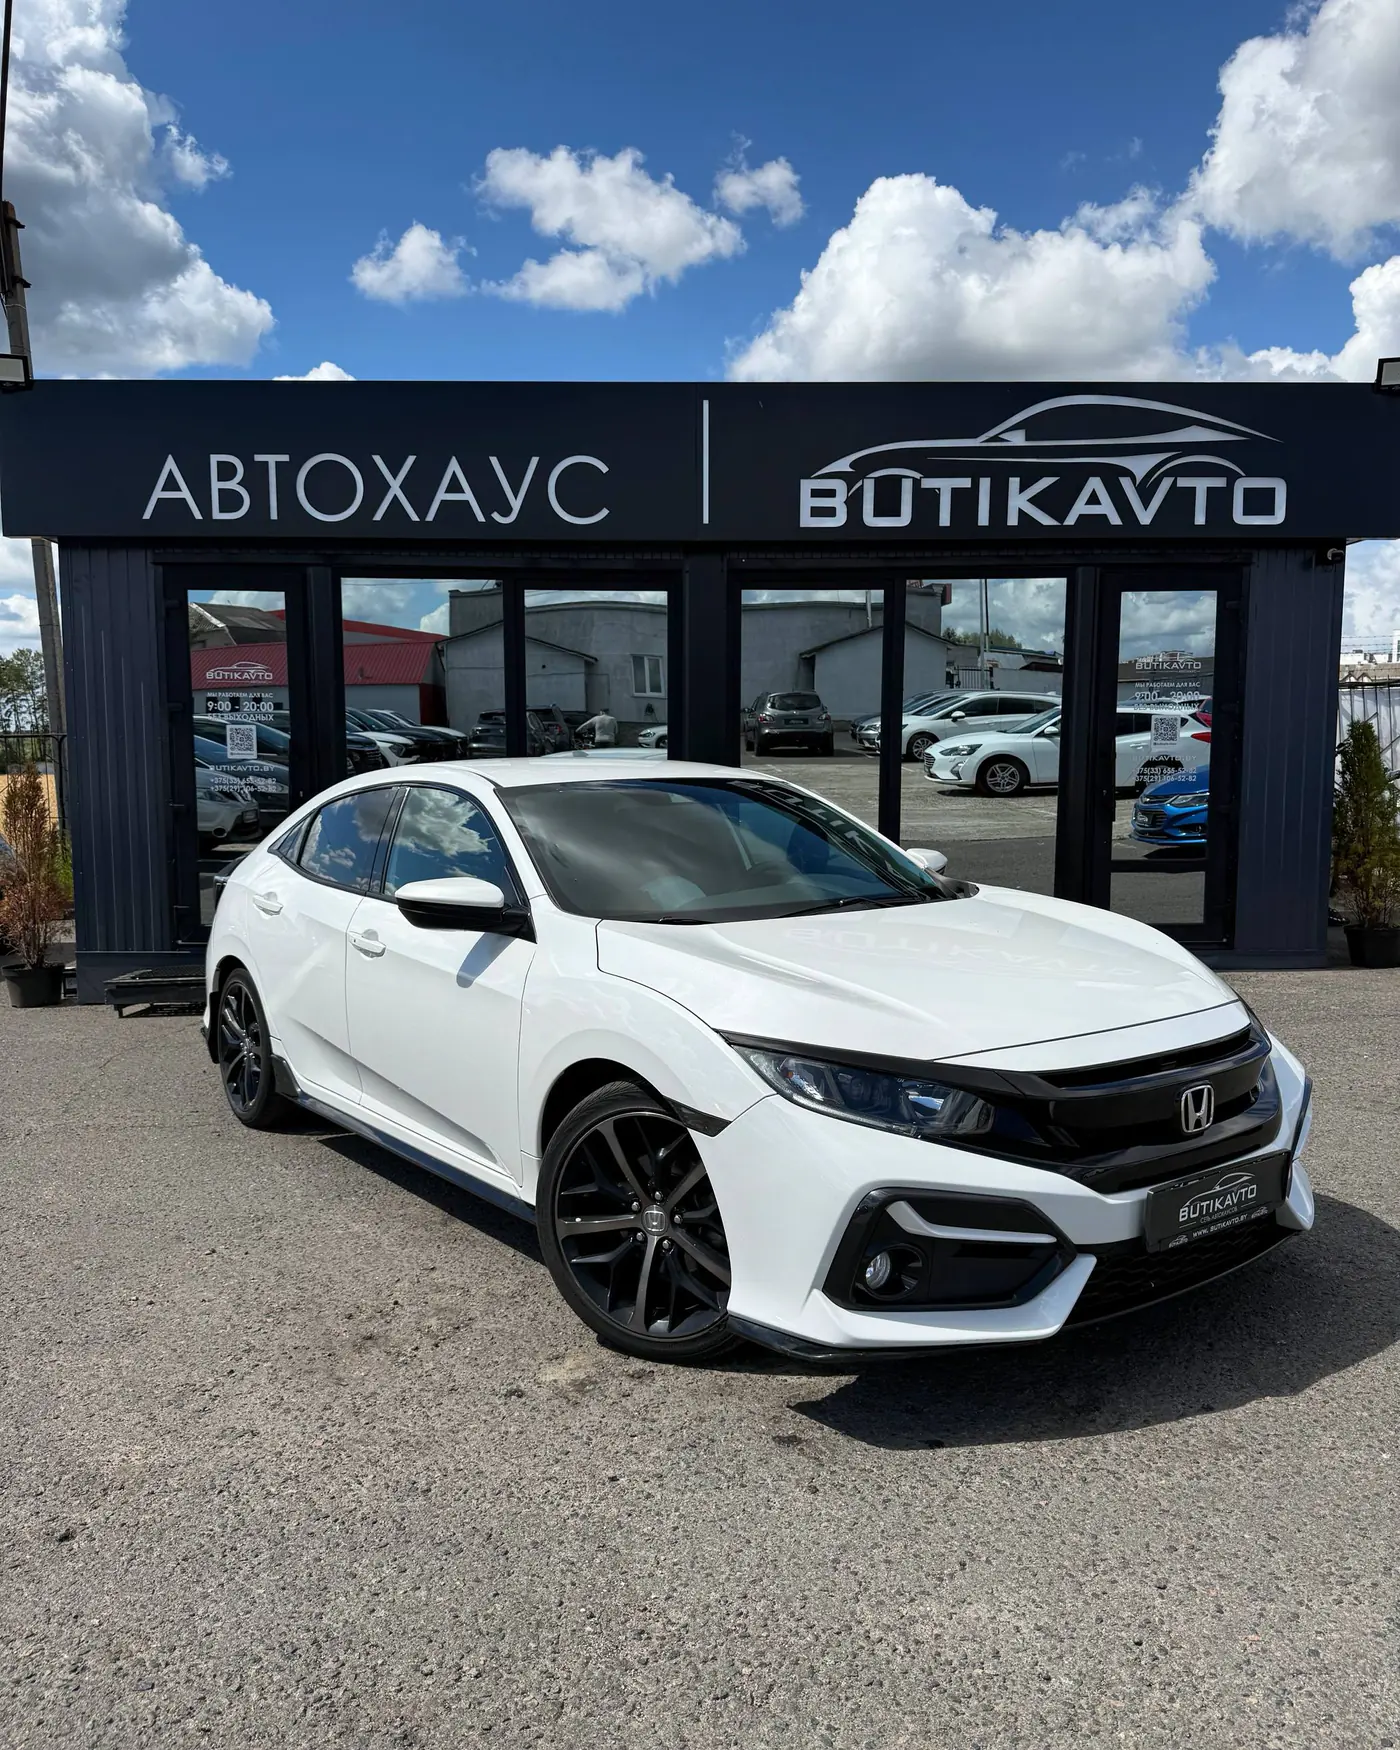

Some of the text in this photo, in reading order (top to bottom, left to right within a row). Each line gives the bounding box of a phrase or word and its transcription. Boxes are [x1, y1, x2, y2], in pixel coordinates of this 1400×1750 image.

[142, 453, 610, 525] АВТОХАУС
[799, 475, 1288, 529] BUTIKAVTO
[206, 671, 273, 680] BUTIKAVTO
[1135, 661, 1202, 670] BUTIKAVTO
[207, 701, 232, 711] 9:00
[243, 701, 274, 712] 20:00
[1179, 1184, 1257, 1222] BUTIKAVTO
